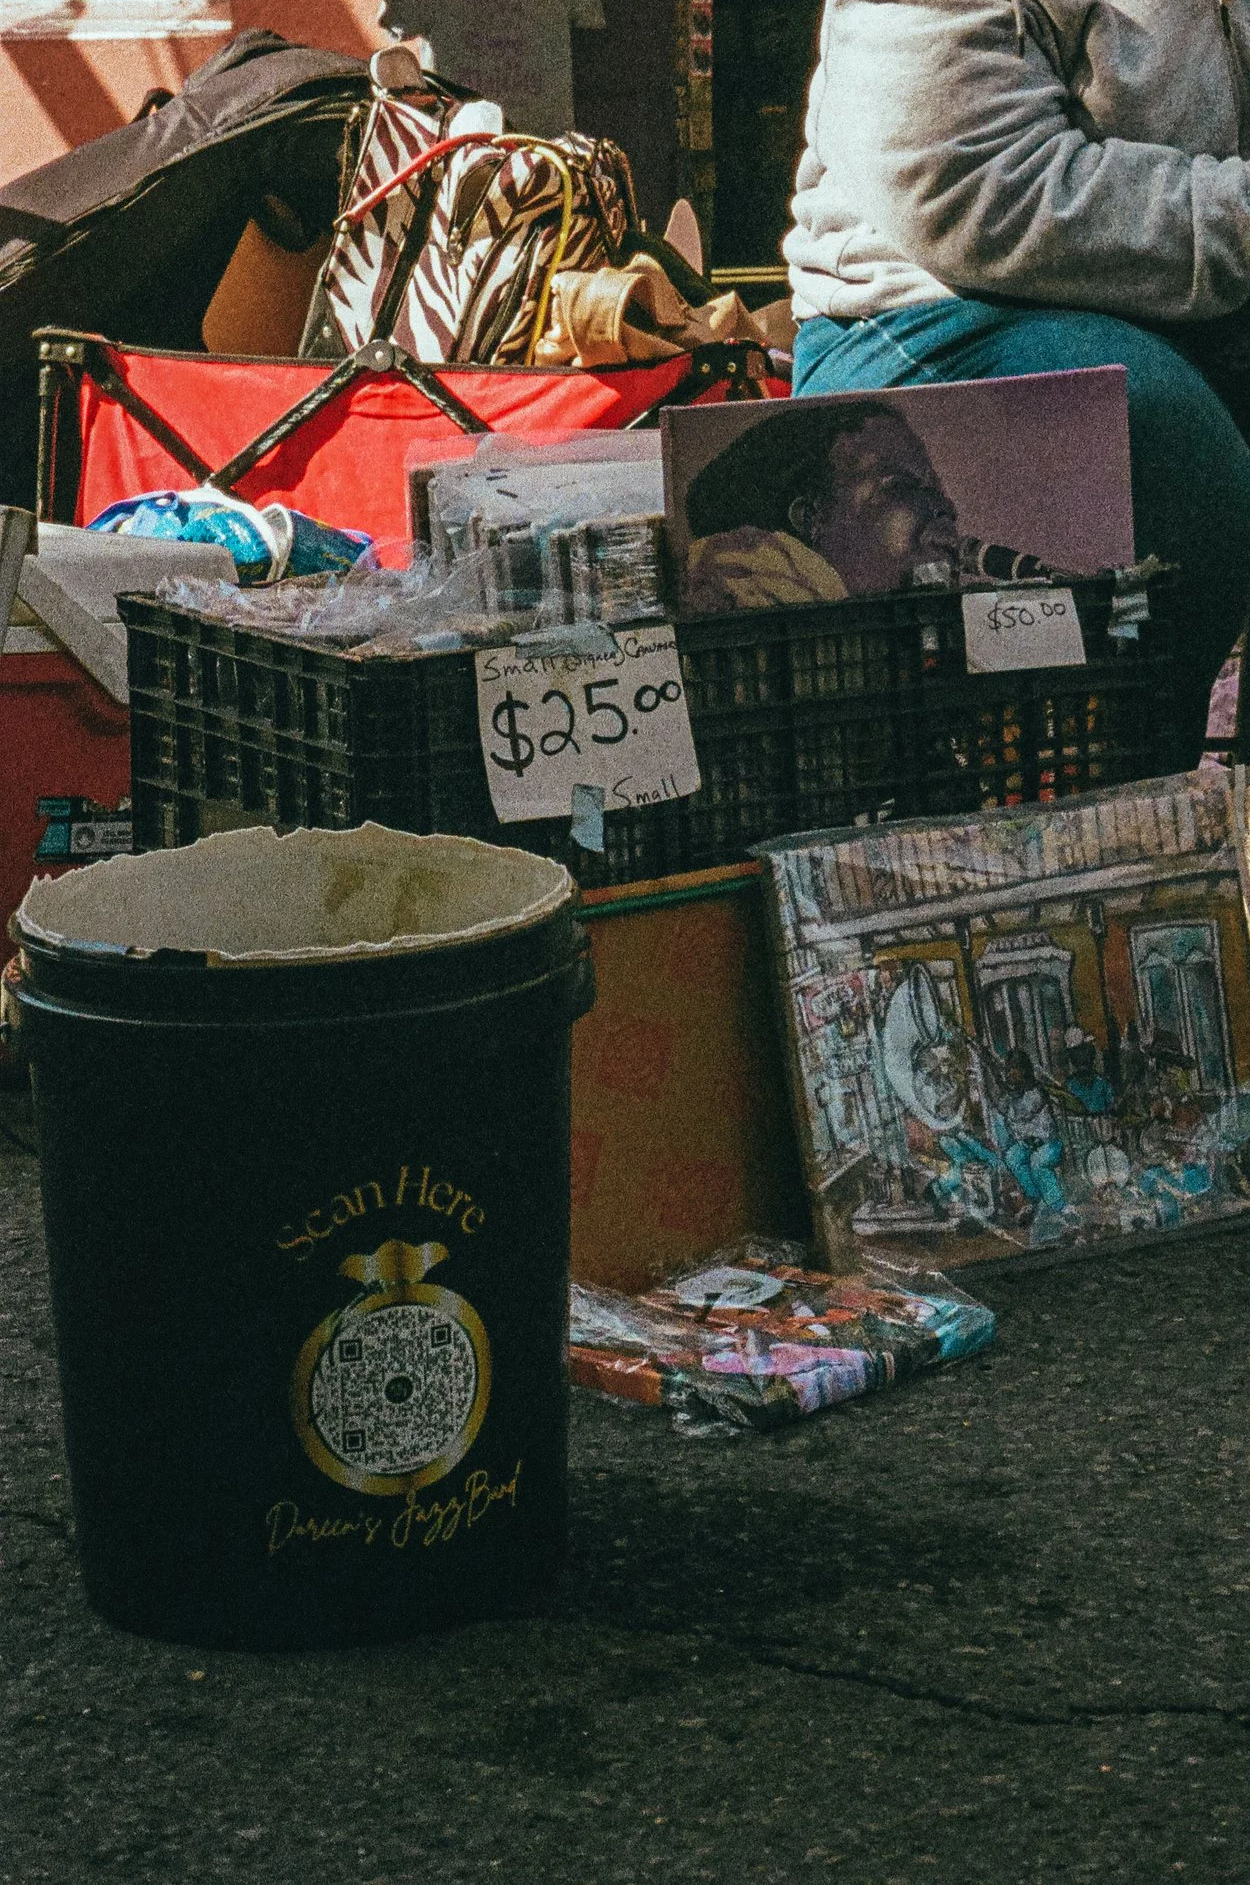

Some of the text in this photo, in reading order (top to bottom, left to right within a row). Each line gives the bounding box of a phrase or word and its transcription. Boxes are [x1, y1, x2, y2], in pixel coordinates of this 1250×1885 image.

[987, 602, 1066, 632] $50.00
[490, 678, 681, 778] $25.00
[612, 774, 678, 807] Small
[276, 1165, 485, 1261] Scan Here
[391, 1490, 470, 1547] Jazz
